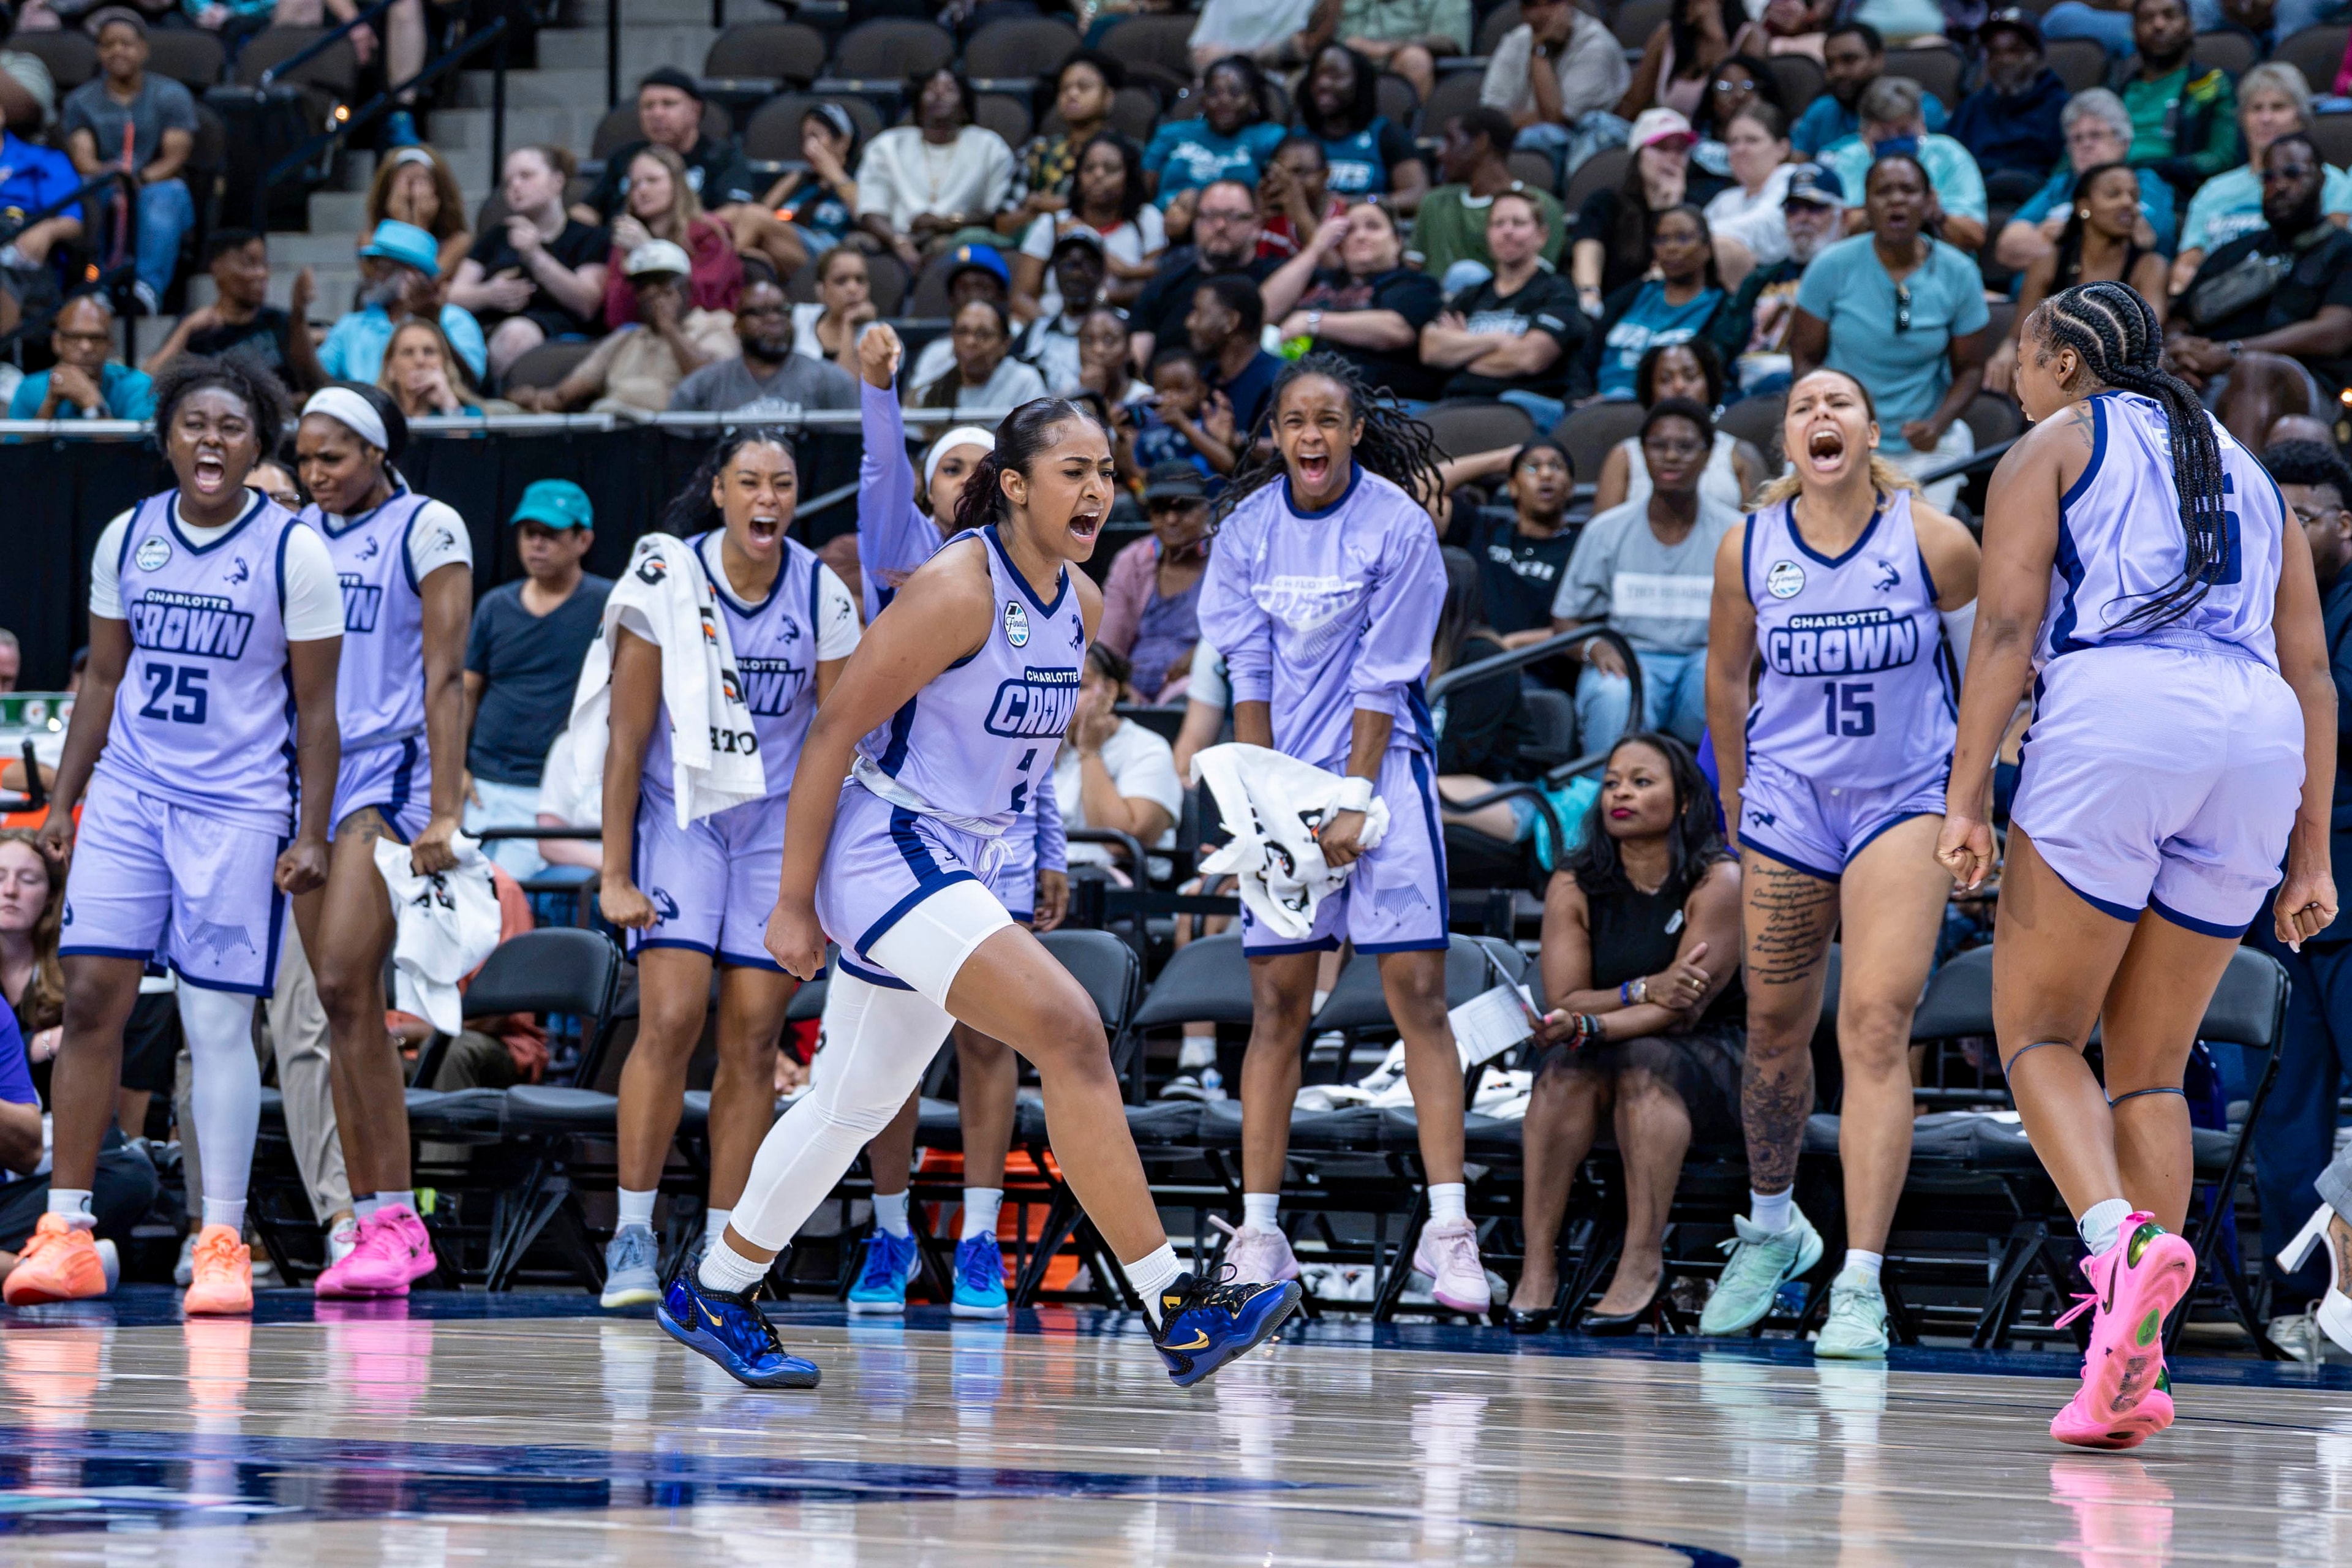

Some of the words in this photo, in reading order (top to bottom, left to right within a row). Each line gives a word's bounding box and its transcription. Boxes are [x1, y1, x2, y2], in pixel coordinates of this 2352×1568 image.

[146, 590, 230, 610] CHARLOTTE
[1005, 616, 1027, 633] Finals
[1790, 611, 1890, 629] CHARLOTTE
[130, 603, 251, 657] CROWN
[1770, 619, 1916, 674] CROWN
[139, 663, 209, 724] 25
[1026, 670, 1078, 683] CHARLOTTE
[990, 684, 1080, 734] CROW
[1824, 682, 1875, 737] 15
